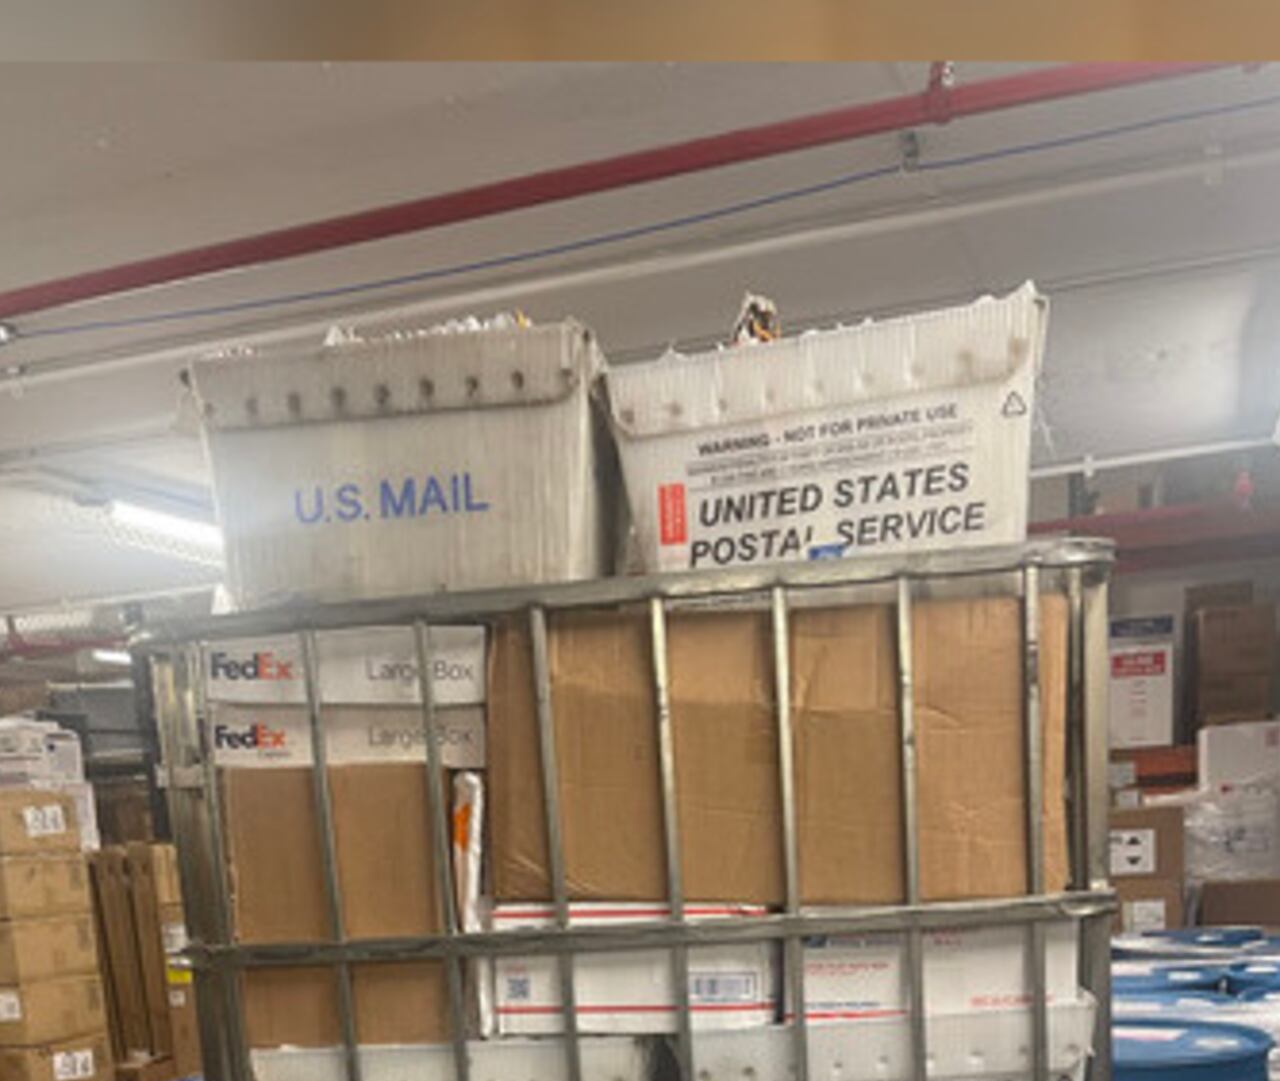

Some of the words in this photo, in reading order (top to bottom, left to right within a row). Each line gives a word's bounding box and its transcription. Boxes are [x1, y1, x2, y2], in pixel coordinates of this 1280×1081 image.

[699, 434, 770, 456] WARNING
[784, 425, 815, 443] NOT
[821, 421, 852, 437] FOR
[857, 410, 919, 431] PRIVATE
[926, 403, 958, 420] USE
[295, 485, 370, 524] U.S.
[379, 473, 489, 518] MAIL
[700, 484, 823, 527] UNITED
[834, 463, 969, 507] STATES
[836, 502, 986, 546] SERVICE
[210, 651, 293, 681] FedEx
[365, 660, 423, 688] Larg
[433, 660, 473, 680] Box
[215, 722, 286, 749] FedEx
[368, 726, 424, 751] Larg
